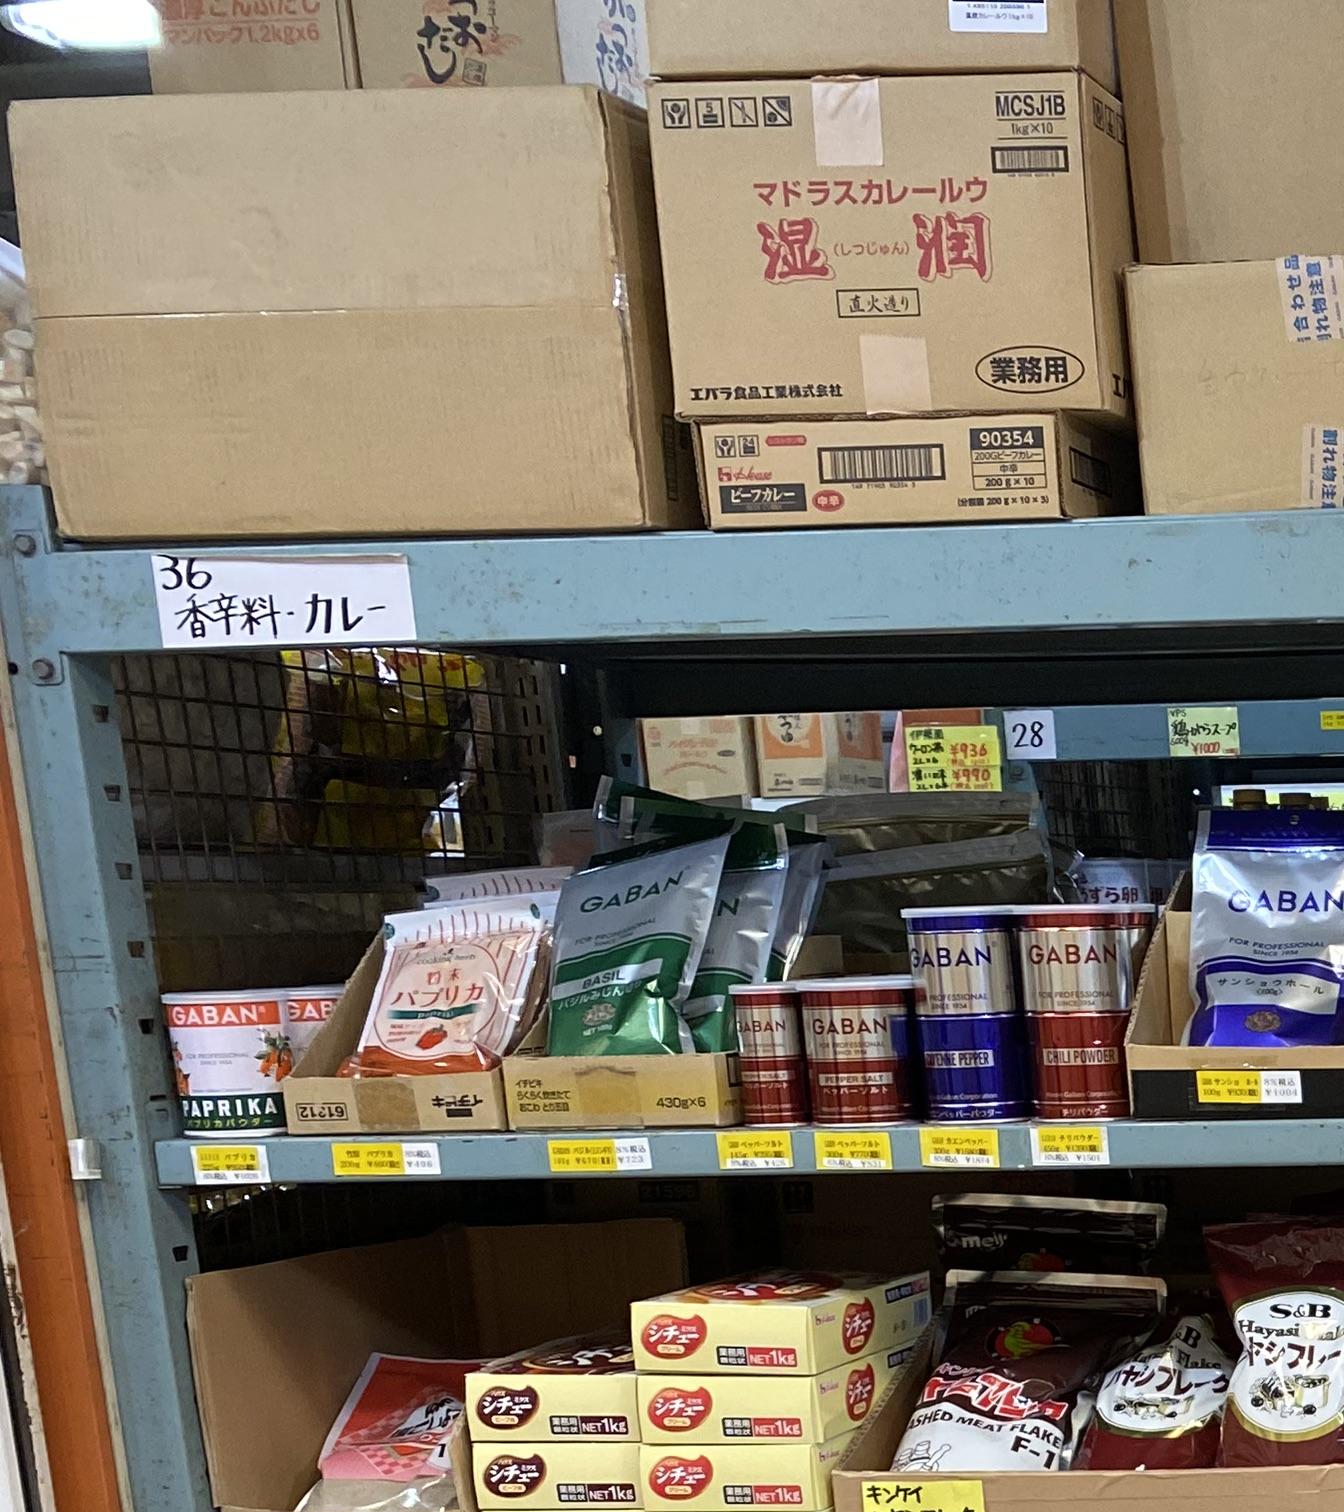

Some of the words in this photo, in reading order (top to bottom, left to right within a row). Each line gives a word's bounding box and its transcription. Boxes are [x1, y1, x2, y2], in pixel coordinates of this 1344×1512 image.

[995, 94, 1065, 118] MCSJ1B
[1010, 121, 1054, 137] 1kg×10
[753, 176, 989, 208] マドラスカレールウ
[990, 355, 1070, 385] 業務用
[690, 383, 843, 402] エバラ食品工業株式会社
[979, 429, 1035, 447] 90354
[730, 487, 796, 504] ビーフカレー
[160, 557, 213, 591] 36
[1011, 720, 1045, 748] 28
[1028, 944, 1118, 966] GABAN
[582, 969, 626, 992] BASIL
[389, 983, 485, 1009] パプリカ
[171, 1006, 263, 1027] GABAN
[811, 1016, 888, 1037] GABAN
[183, 1097, 278, 1118] PAPRIKA
[656, 1096, 707, 1110] 430g×6
[1267, 1301, 1333, 1321] S&B
[866, 1484, 923, 1505] キンケイ
